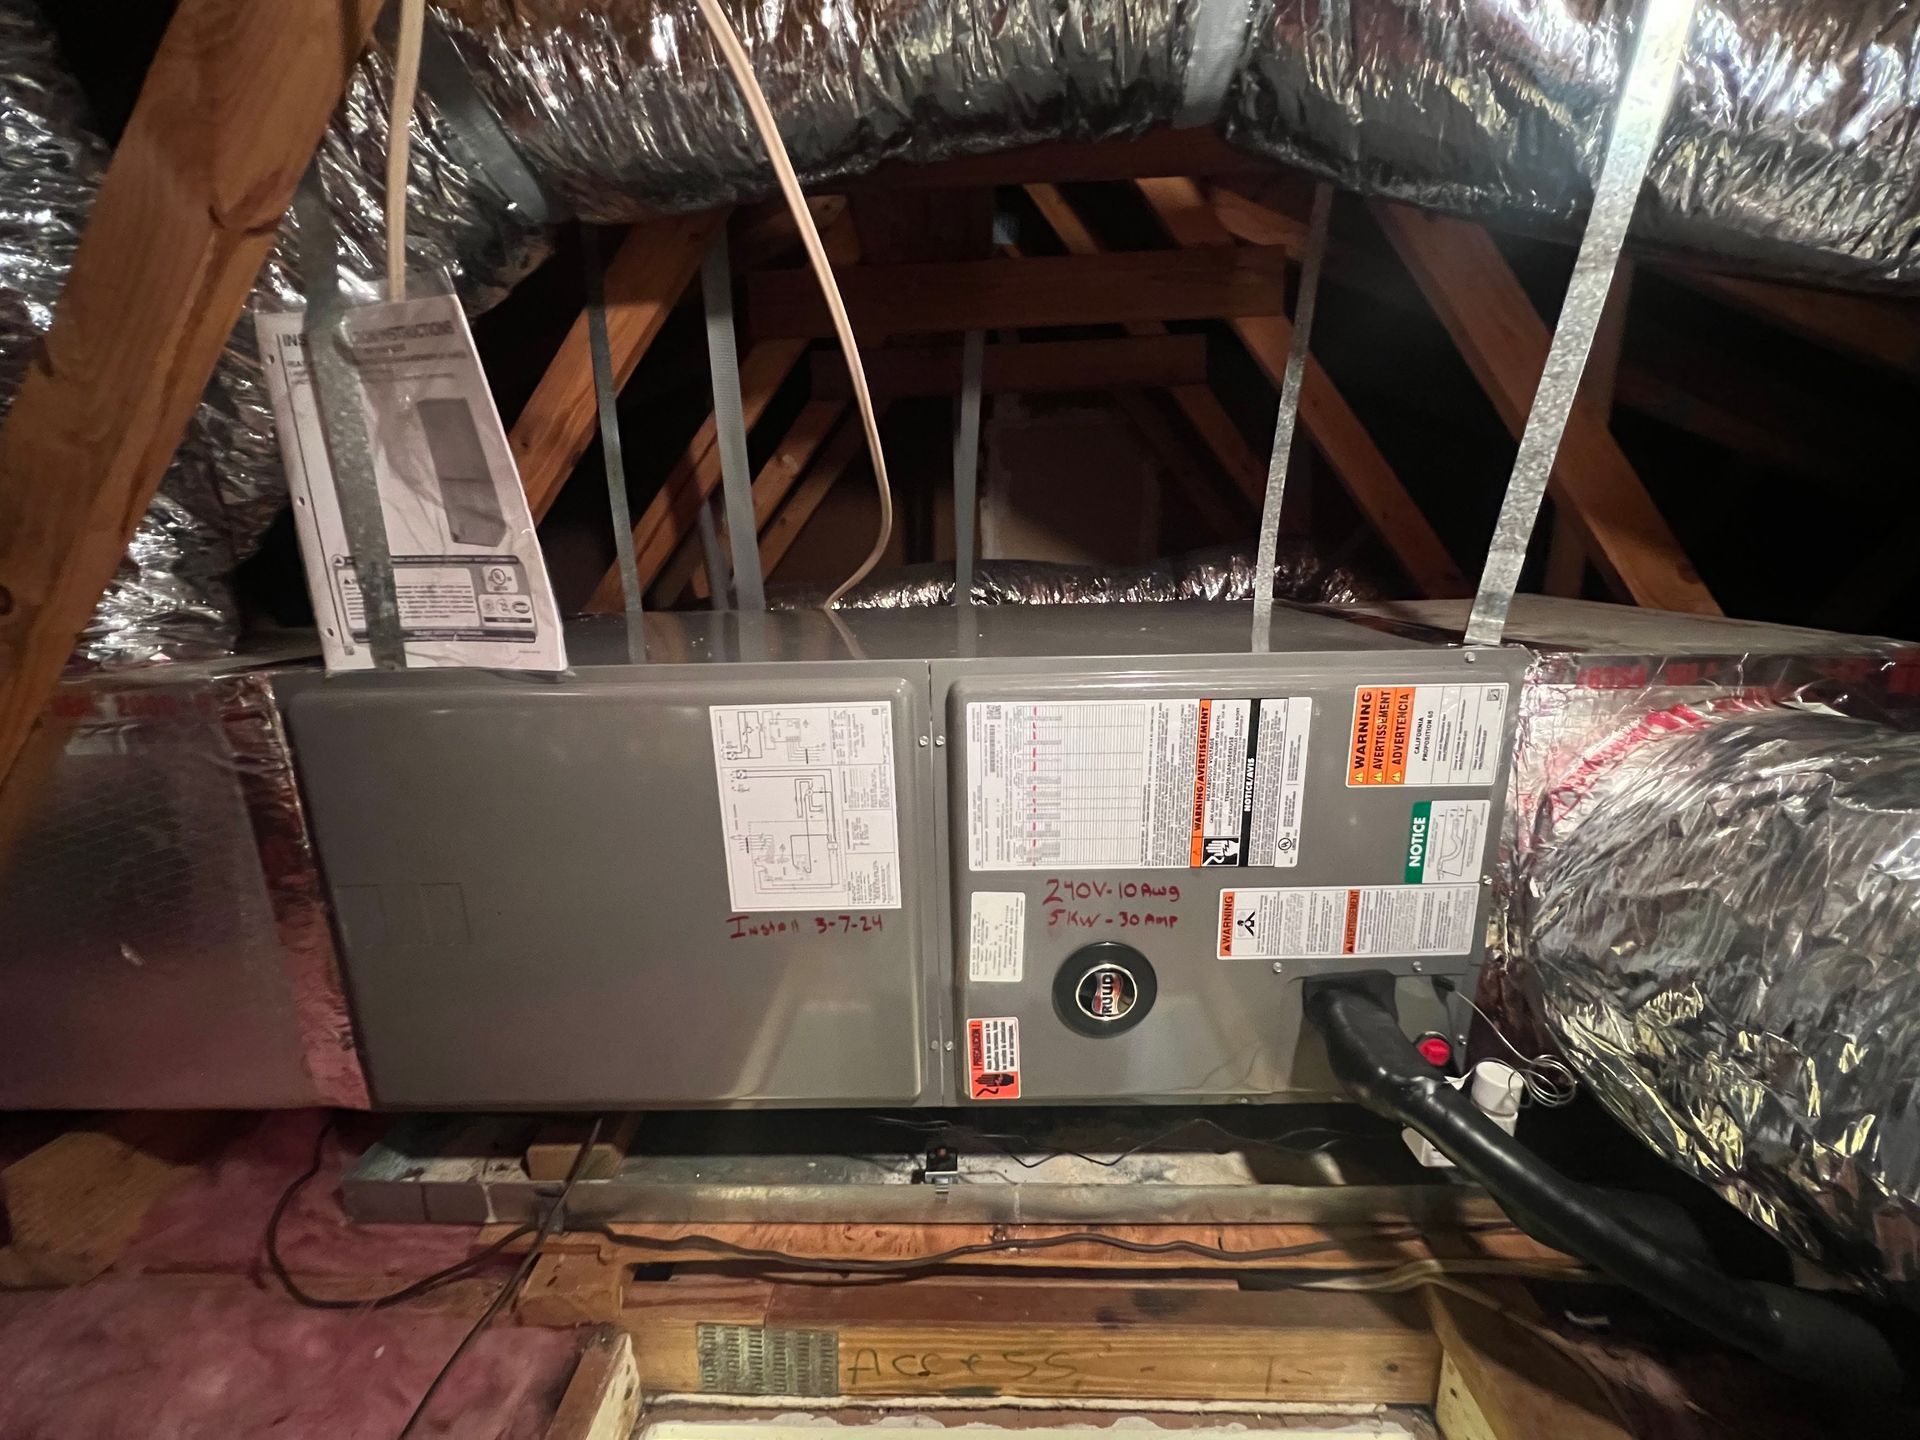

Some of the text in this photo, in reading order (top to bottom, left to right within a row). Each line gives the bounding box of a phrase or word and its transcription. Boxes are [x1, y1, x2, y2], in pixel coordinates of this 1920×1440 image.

[1354, 692, 1371, 769] WARNING
[1373, 691, 1391, 769] AVERTISSEMENT
[1392, 693, 1409, 765] ADVERTENCIA
[1414, 717, 1424, 754] CALIFORNIA
[1422, 719, 1433, 761] PROPOSITION
[1194, 707, 1208, 831] WARNING/AVERTISSEMENT
[1244, 757, 1255, 812] NOTICE/AVIS
[1409, 817, 1426, 867] NOTICE
[814, 914, 883, 934] 3-7-24
[1222, 896, 1233, 944] WARNING
[1345, 891, 1359, 945] AVERTISSEMENT
[1102, 974, 1113, 1013] RUUD
